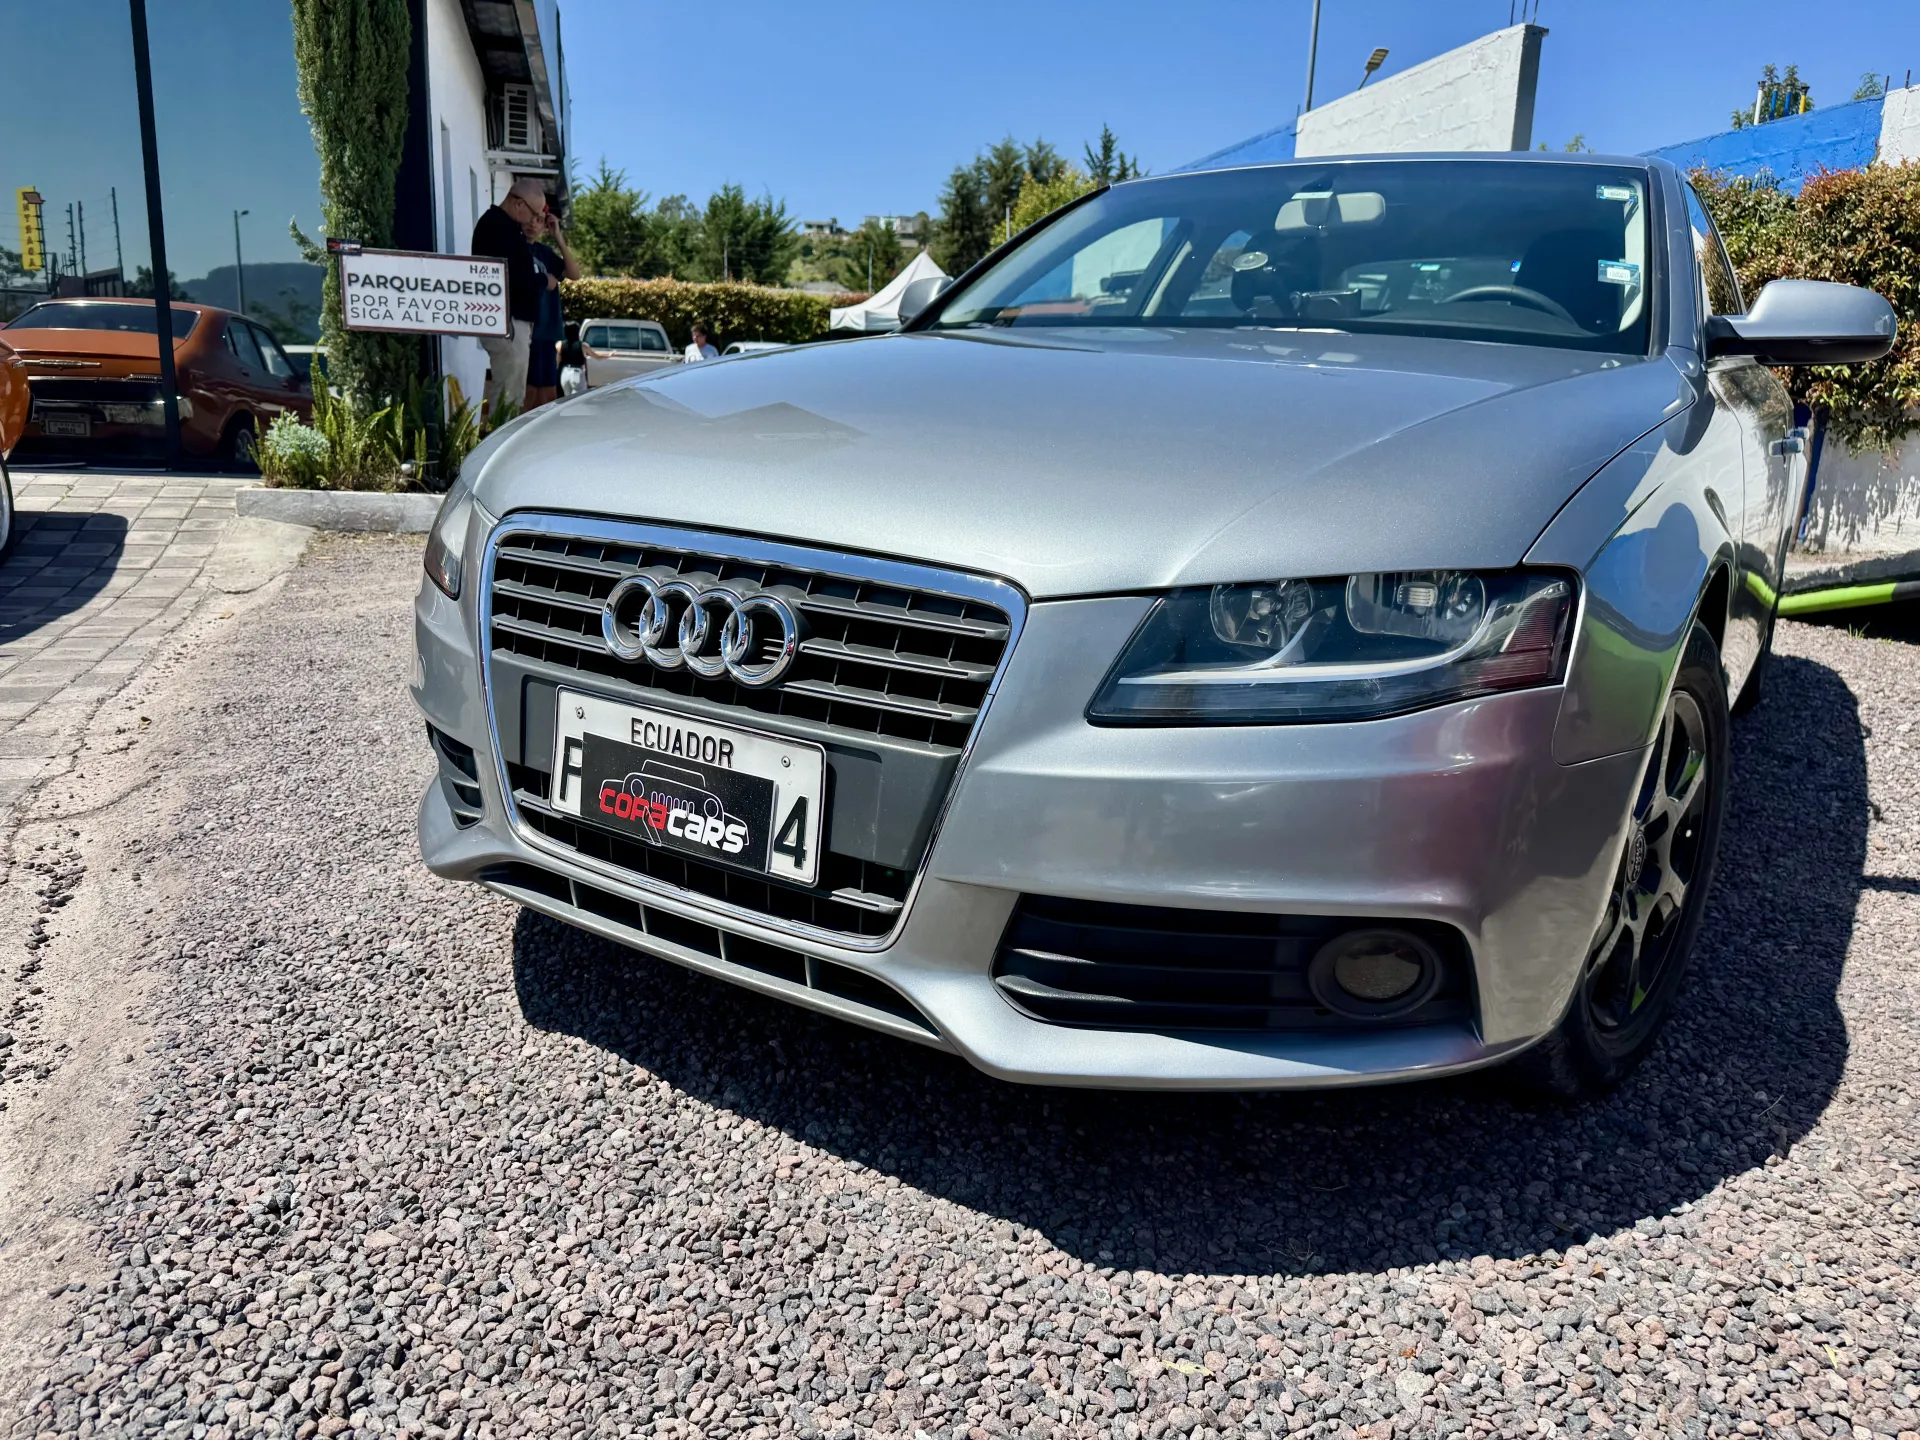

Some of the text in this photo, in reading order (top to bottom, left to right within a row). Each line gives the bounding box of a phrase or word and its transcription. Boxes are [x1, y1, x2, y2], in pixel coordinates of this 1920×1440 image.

[347, 273, 502, 297] PARQUEADERO
[350, 294, 459, 311] POR FAVOR
[350, 307, 498, 327] SIGA AL FONDO
[630, 717, 734, 768] ECUADOR
[774, 794, 809, 870] 4
